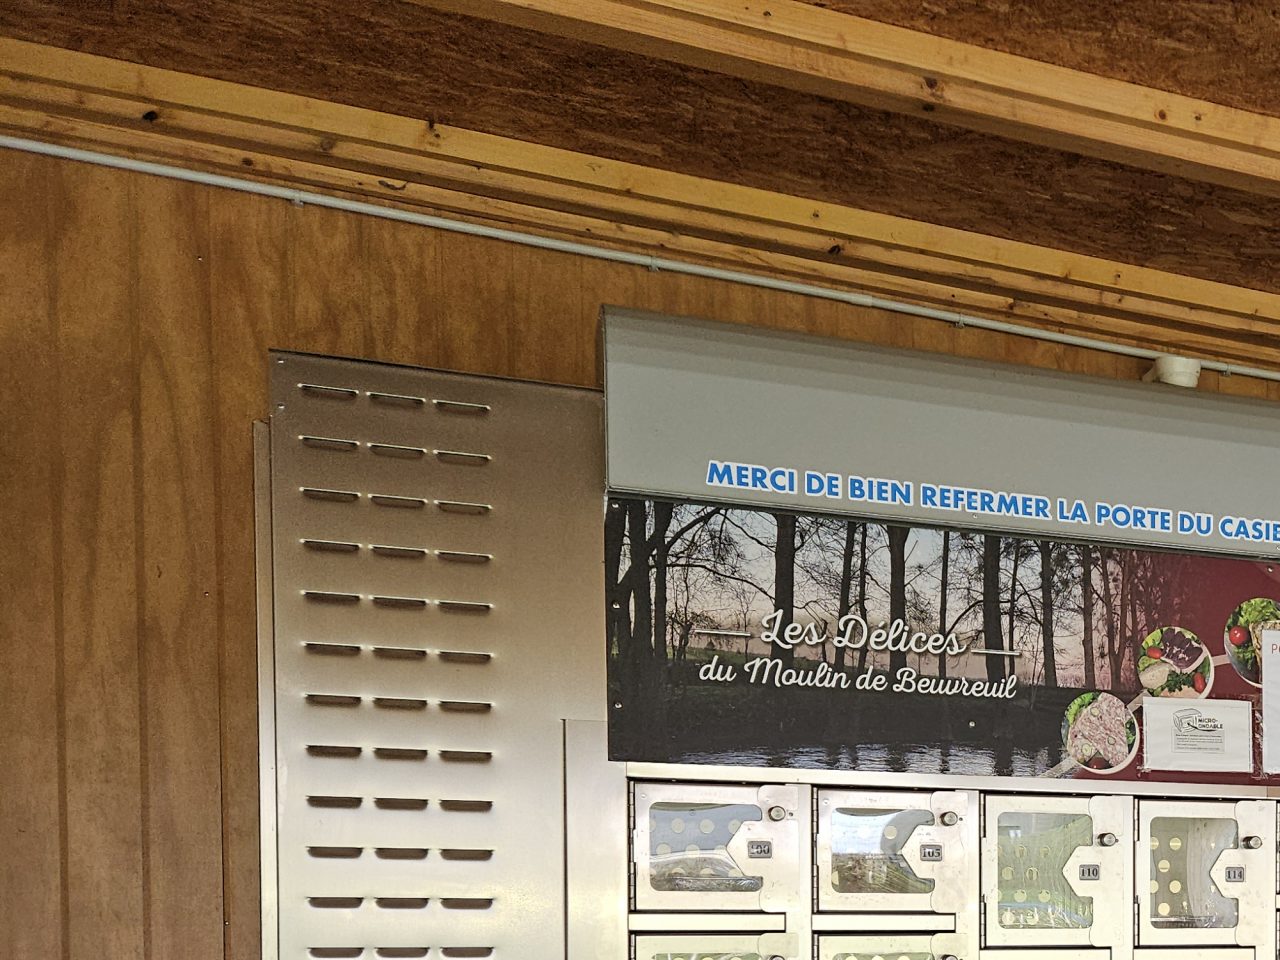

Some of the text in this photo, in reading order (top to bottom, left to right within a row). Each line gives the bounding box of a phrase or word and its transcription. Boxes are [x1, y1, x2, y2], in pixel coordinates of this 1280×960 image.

[709, 463, 795, 491] MERCI
[807, 473, 838, 496] DE
[850, 479, 911, 504] BIEN
[923, 485, 1049, 517] REFERMER
[1059, 501, 1087, 521] LA
[1097, 505, 1170, 531] PORTE
[1180, 514, 1211, 534] DU
[761, 608, 966, 655] Les Délices
[699, 656, 1017, 699] du Moulin de Beuvreuil
[922, 848, 941, 858] 105
[1080, 867, 1098, 877] 110
[1227, 869, 1243, 879] 114
